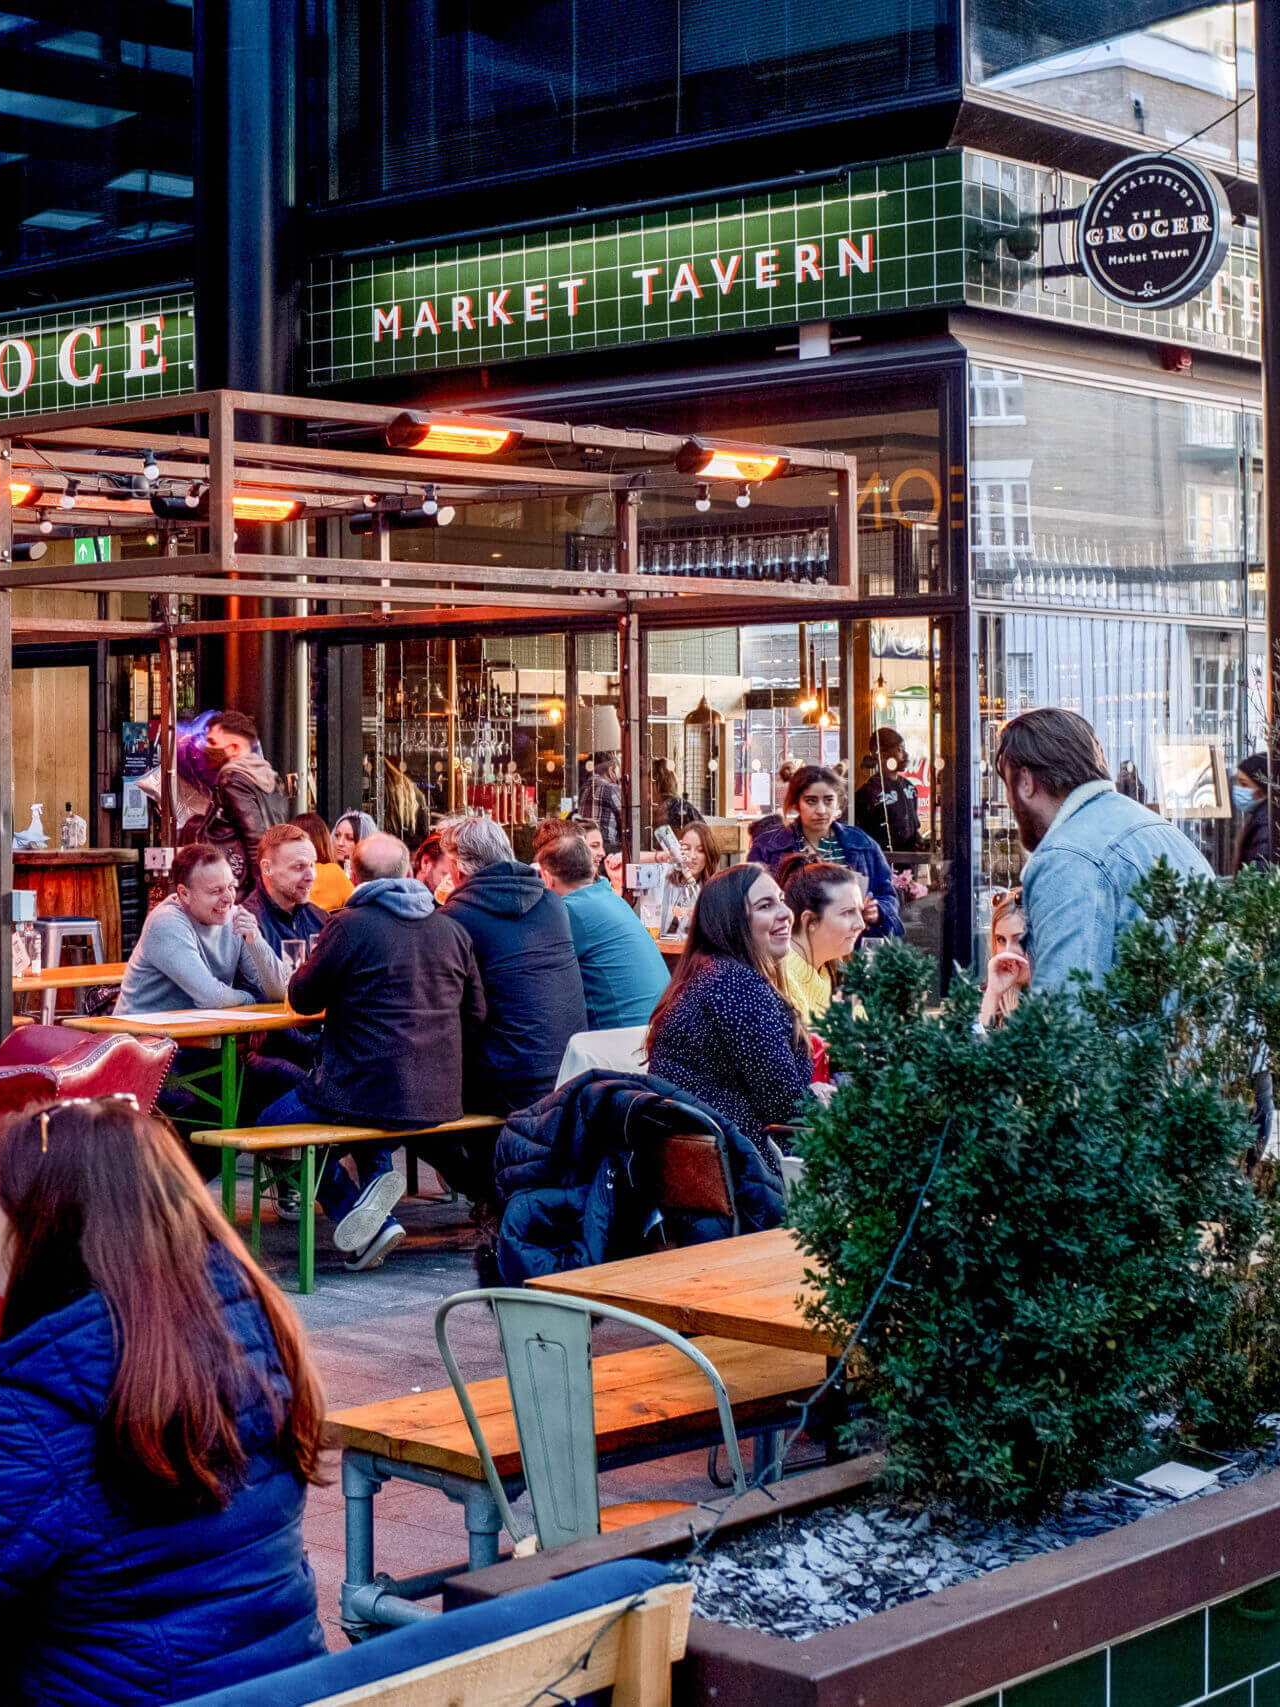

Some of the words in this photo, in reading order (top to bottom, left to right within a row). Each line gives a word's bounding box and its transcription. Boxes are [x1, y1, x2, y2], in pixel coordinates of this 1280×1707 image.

[1103, 175, 1194, 219] SPITALFIELDS
[1085, 214, 1212, 246] GROCER
[1132, 209, 1161, 220] THE
[1108, 253, 1147, 265] Market
[1151, 249, 1189, 260] Tavern
[373, 278, 586, 342] MARKET
[632, 233, 874, 307] TAVERN
